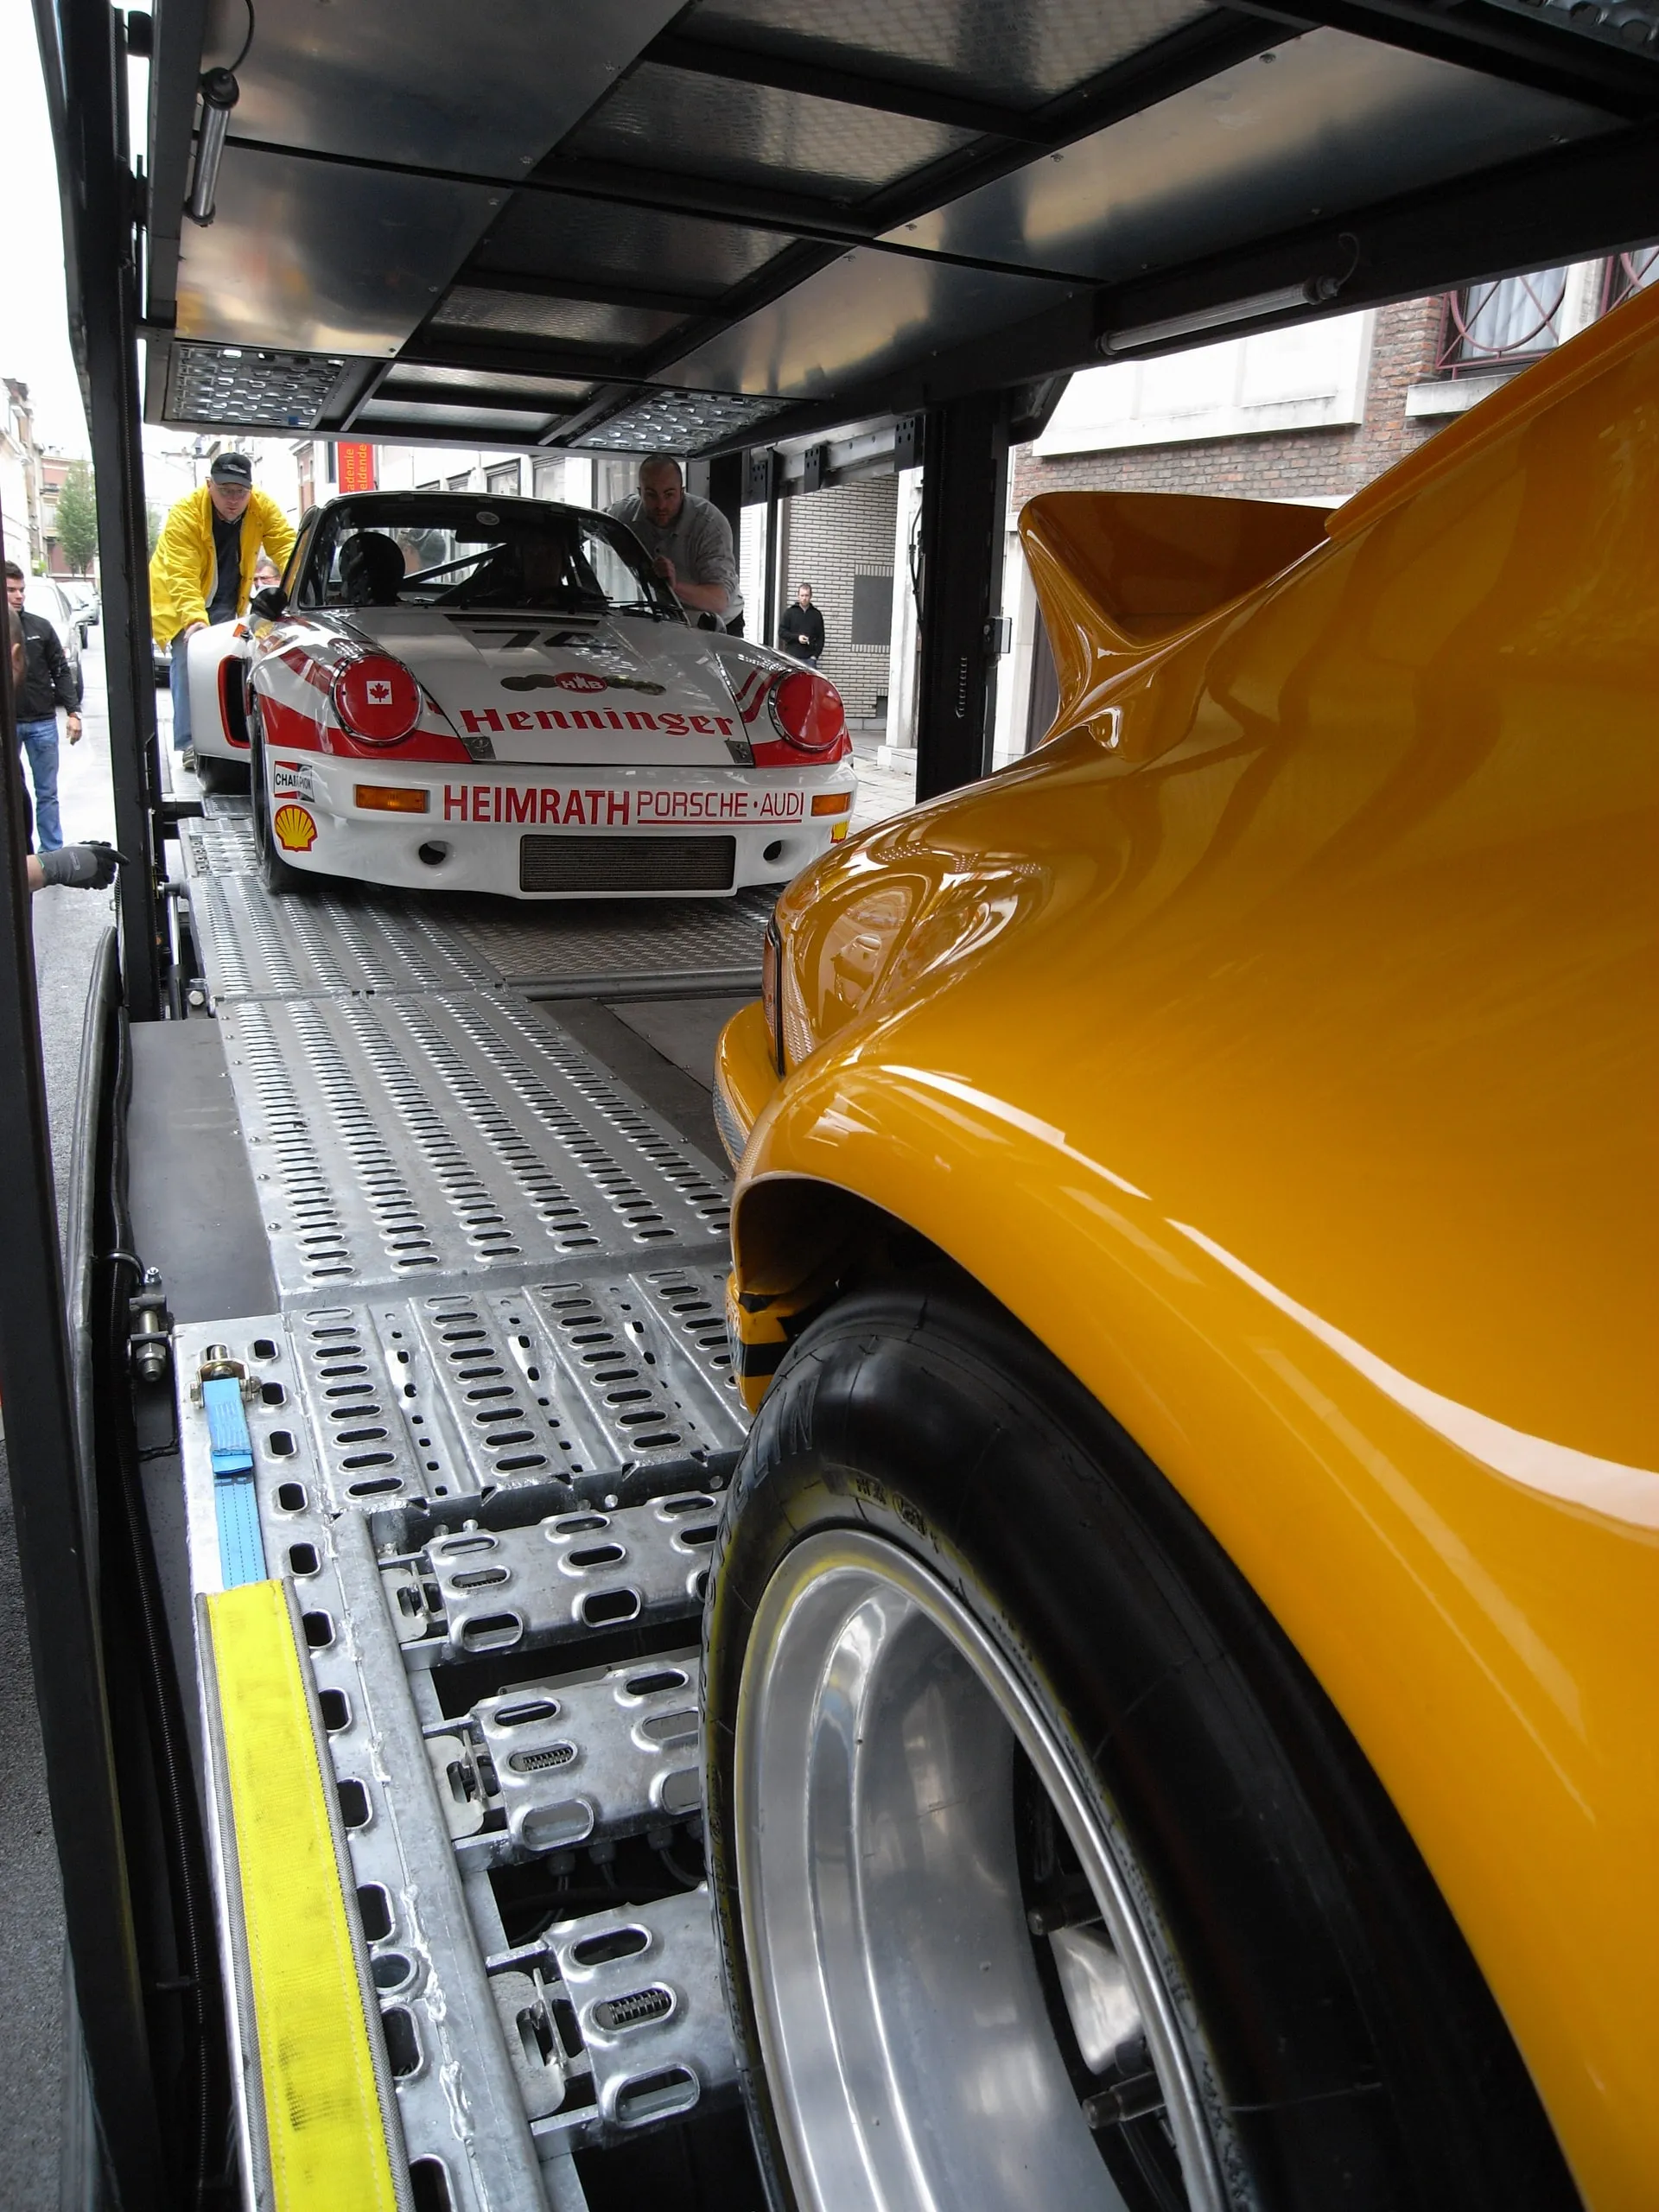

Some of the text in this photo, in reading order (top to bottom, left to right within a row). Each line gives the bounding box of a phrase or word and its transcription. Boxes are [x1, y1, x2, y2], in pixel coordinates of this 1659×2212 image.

[344, 448, 355, 493] ademie
[460, 707, 734, 736] Henninger
[443, 785, 630, 825] HEIMRATH
[637, 791, 749, 817] PORSCHE
